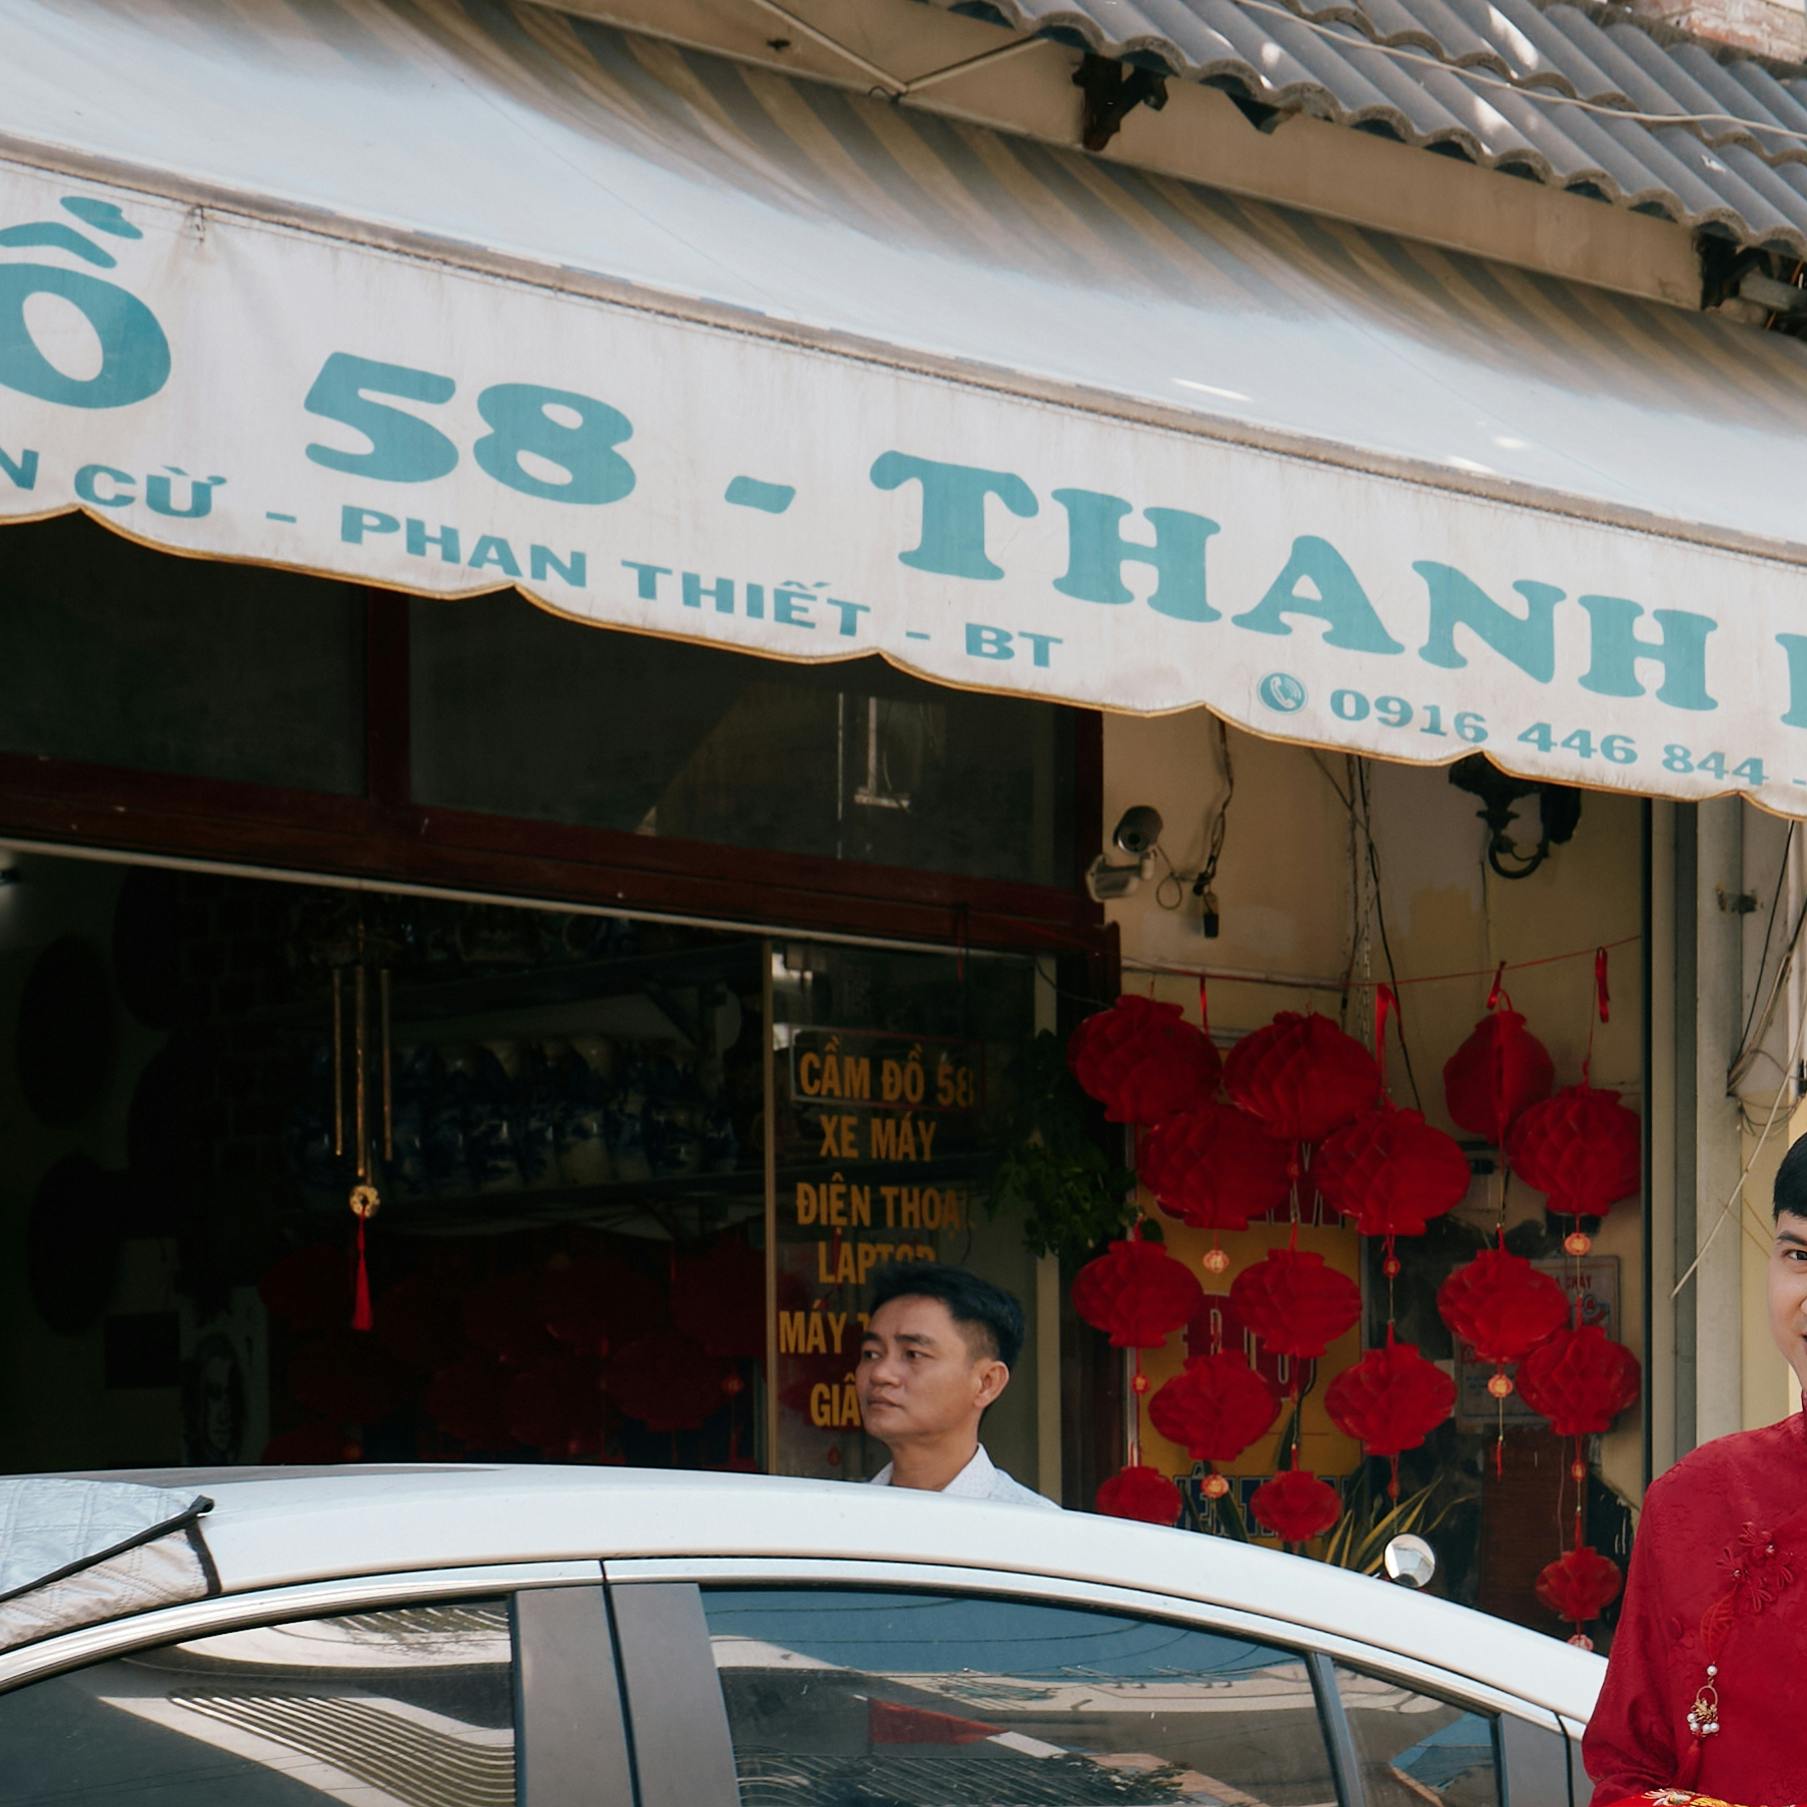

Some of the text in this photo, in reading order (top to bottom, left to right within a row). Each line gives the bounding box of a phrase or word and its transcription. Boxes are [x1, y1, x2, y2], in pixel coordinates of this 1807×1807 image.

[303, 351, 638, 506] 58
[868, 450, 1719, 712] THANH
[73, 464, 227, 519] CỪ
[340, 504, 588, 588] PHAN
[621, 558, 871, 637] THIẾT
[964, 622, 1064, 669] BT
[1328, 688, 1490, 744] 0916
[1516, 721, 1639, 766] 446
[1661, 742, 1770, 789] 844
[800, 1035, 976, 1108] CẦM ĐỒ 58
[818, 1110, 937, 1163] XE MÁY
[796, 1171, 871, 1236] ĐIỆN
[778, 1299, 848, 1355] MÁY
[810, 1371, 862, 1428] GIÂ
